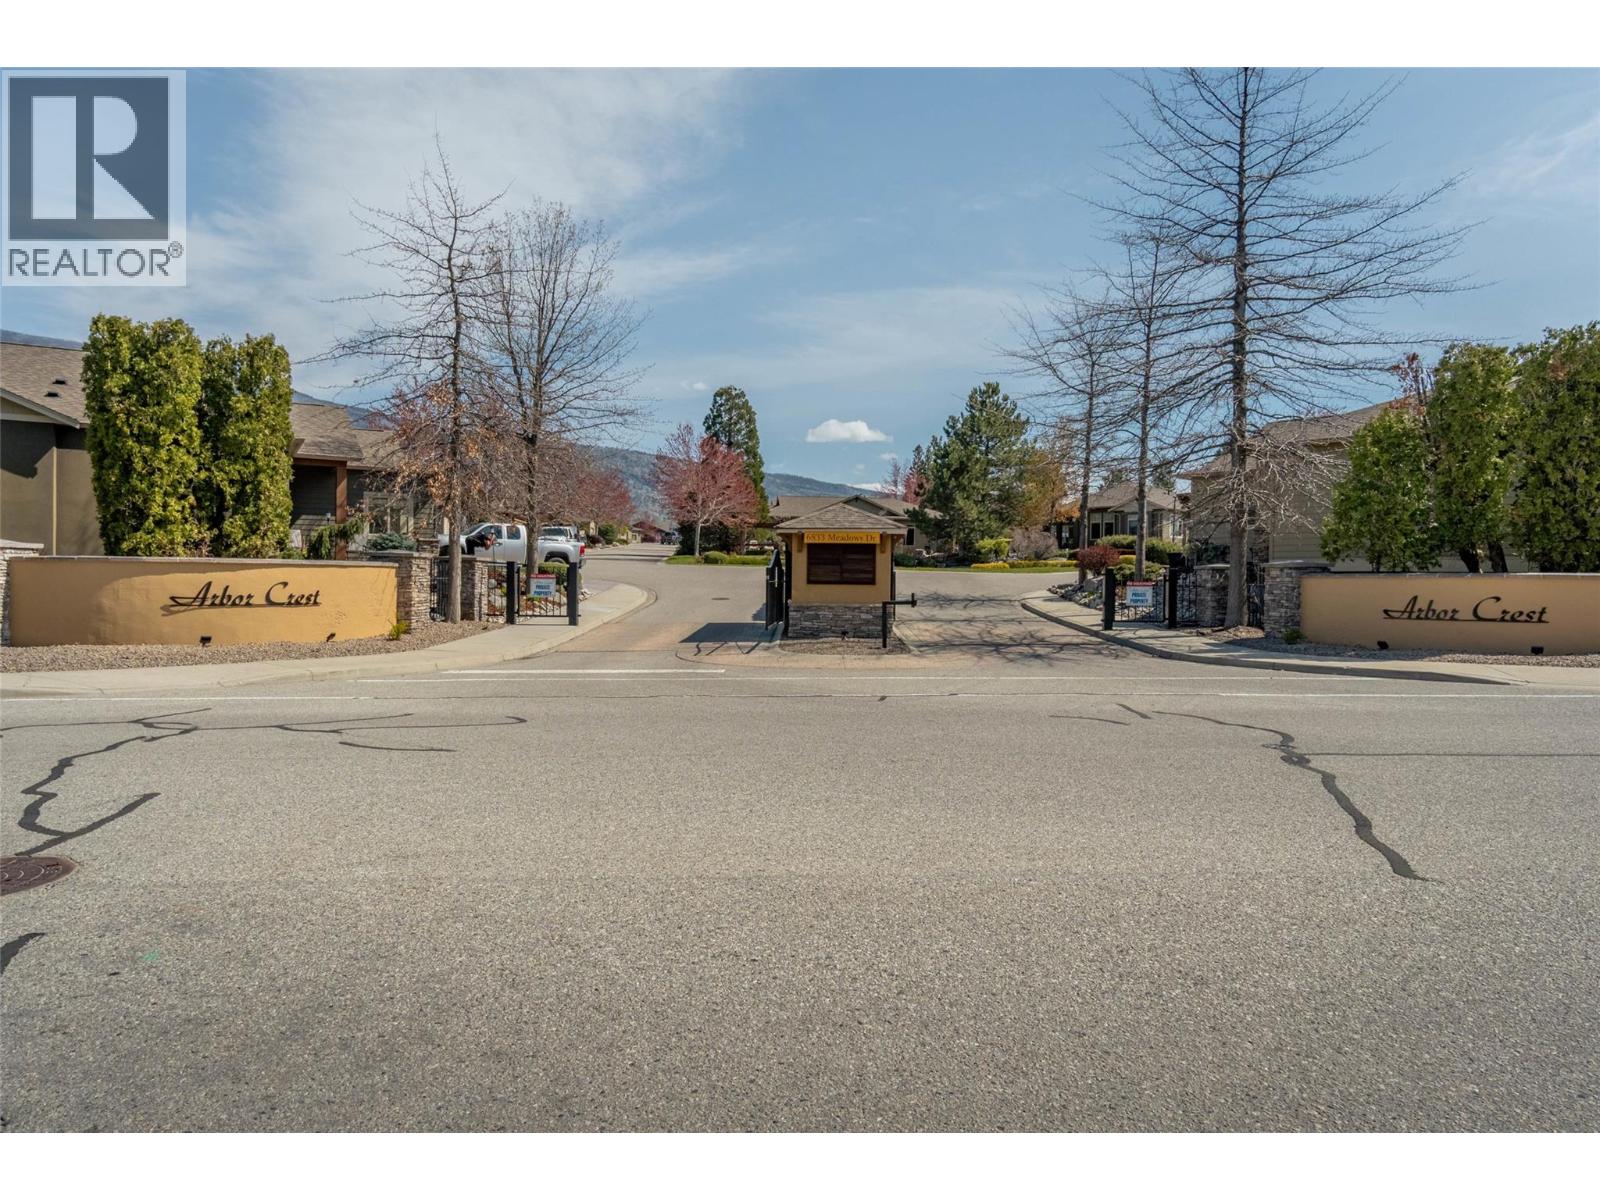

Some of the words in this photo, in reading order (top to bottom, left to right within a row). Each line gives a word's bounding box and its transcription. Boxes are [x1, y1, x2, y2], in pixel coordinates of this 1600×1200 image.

[828, 533, 863, 542] Meadows
[169, 580, 254, 607] Arbor
[265, 581, 321, 607] Crest
[1383, 595, 1460, 621] Arbor
[1472, 596, 1549, 623] Crest
